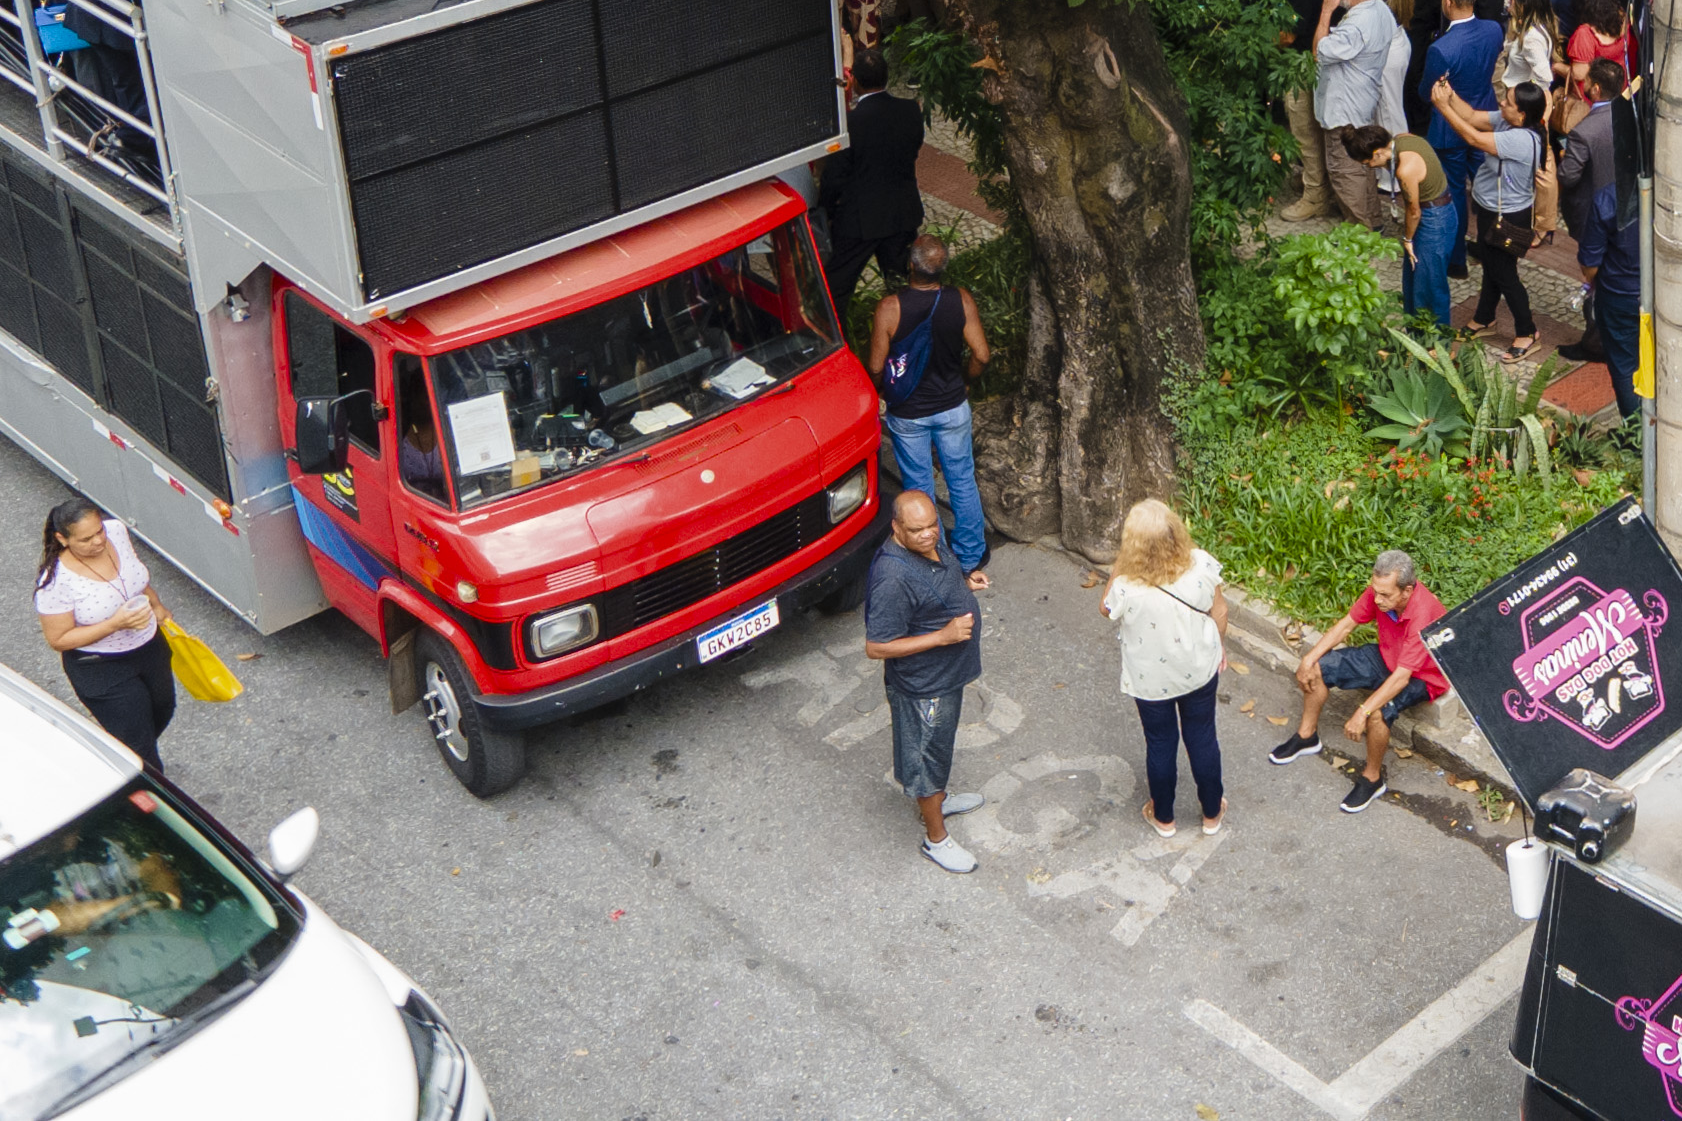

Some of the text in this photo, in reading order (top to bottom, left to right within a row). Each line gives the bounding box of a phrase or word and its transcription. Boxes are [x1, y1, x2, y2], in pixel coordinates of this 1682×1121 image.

[1506, 552, 1578, 607] (31) 99434-0171
[707, 612, 771, 655] GKW2C85
[1533, 601, 1626, 686] Meninas
[1555, 637, 1638, 702] HOT DOG DAS
